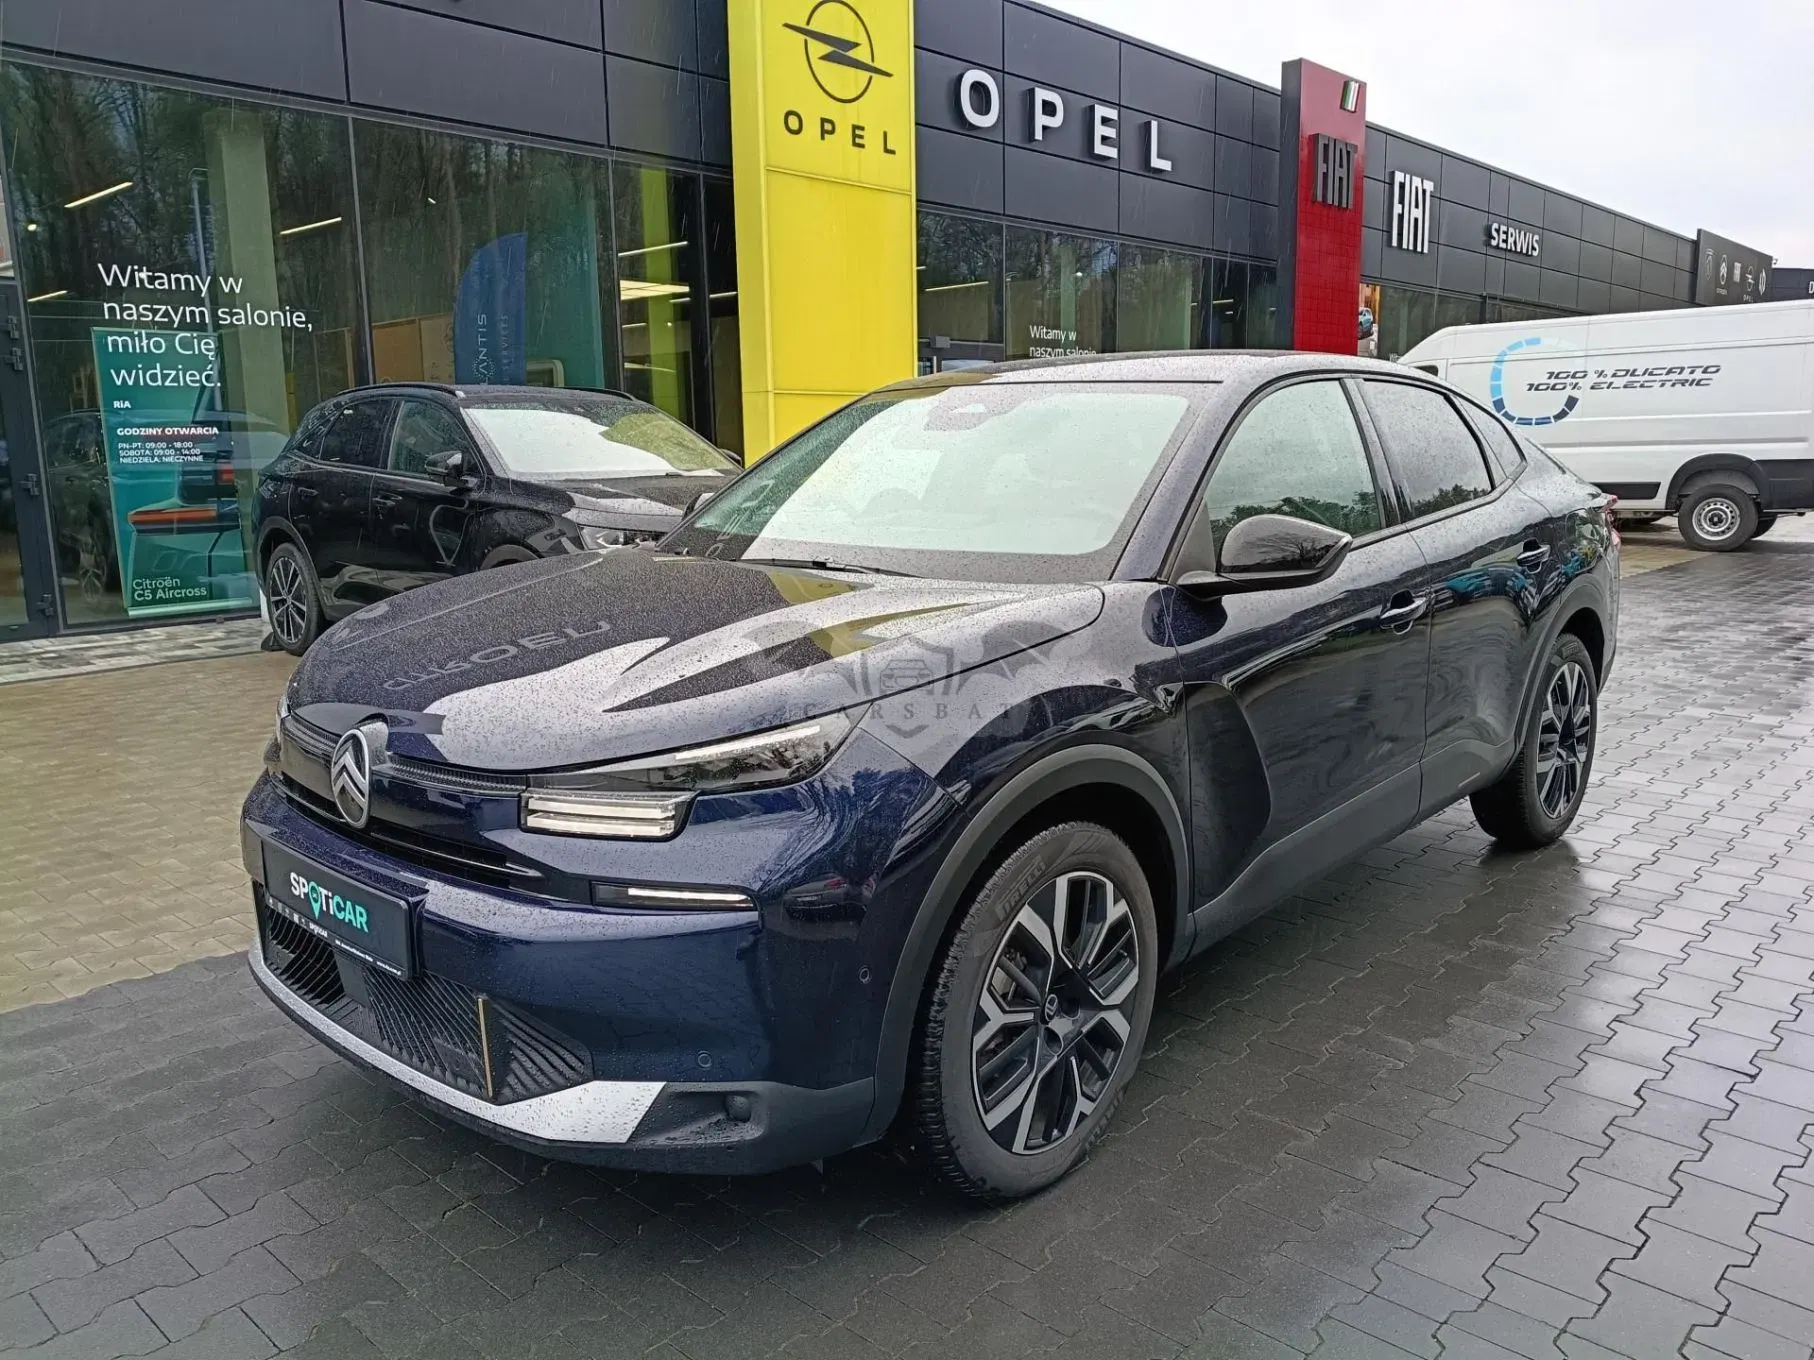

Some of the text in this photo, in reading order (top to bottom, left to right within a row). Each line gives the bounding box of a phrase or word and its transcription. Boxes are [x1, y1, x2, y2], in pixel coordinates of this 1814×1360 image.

[783, 109, 897, 155] OPEL
[959, 69, 1173, 172] OPEL
[1315, 133, 1358, 209] FIAT
[1391, 170, 1434, 254] FIAT
[1490, 222, 1540, 257] SERWIS
[98, 263, 243, 297] Witamy w
[103, 302, 313, 332] naszym salonie,
[107, 333, 217, 361] miło Cię
[1029, 325, 1077, 343] Witamy w
[111, 364, 222, 388] widzieć.
[1526, 377, 1714, 392] 100% ELECTRIC
[1546, 370, 1588, 380] 100
[116, 426, 219, 436] GODZINY OTWARCIA
[119, 449, 153, 457] SOBOTA:
[132, 577, 180, 590] Citroën
[134, 587, 207, 601] C5 Aircross
